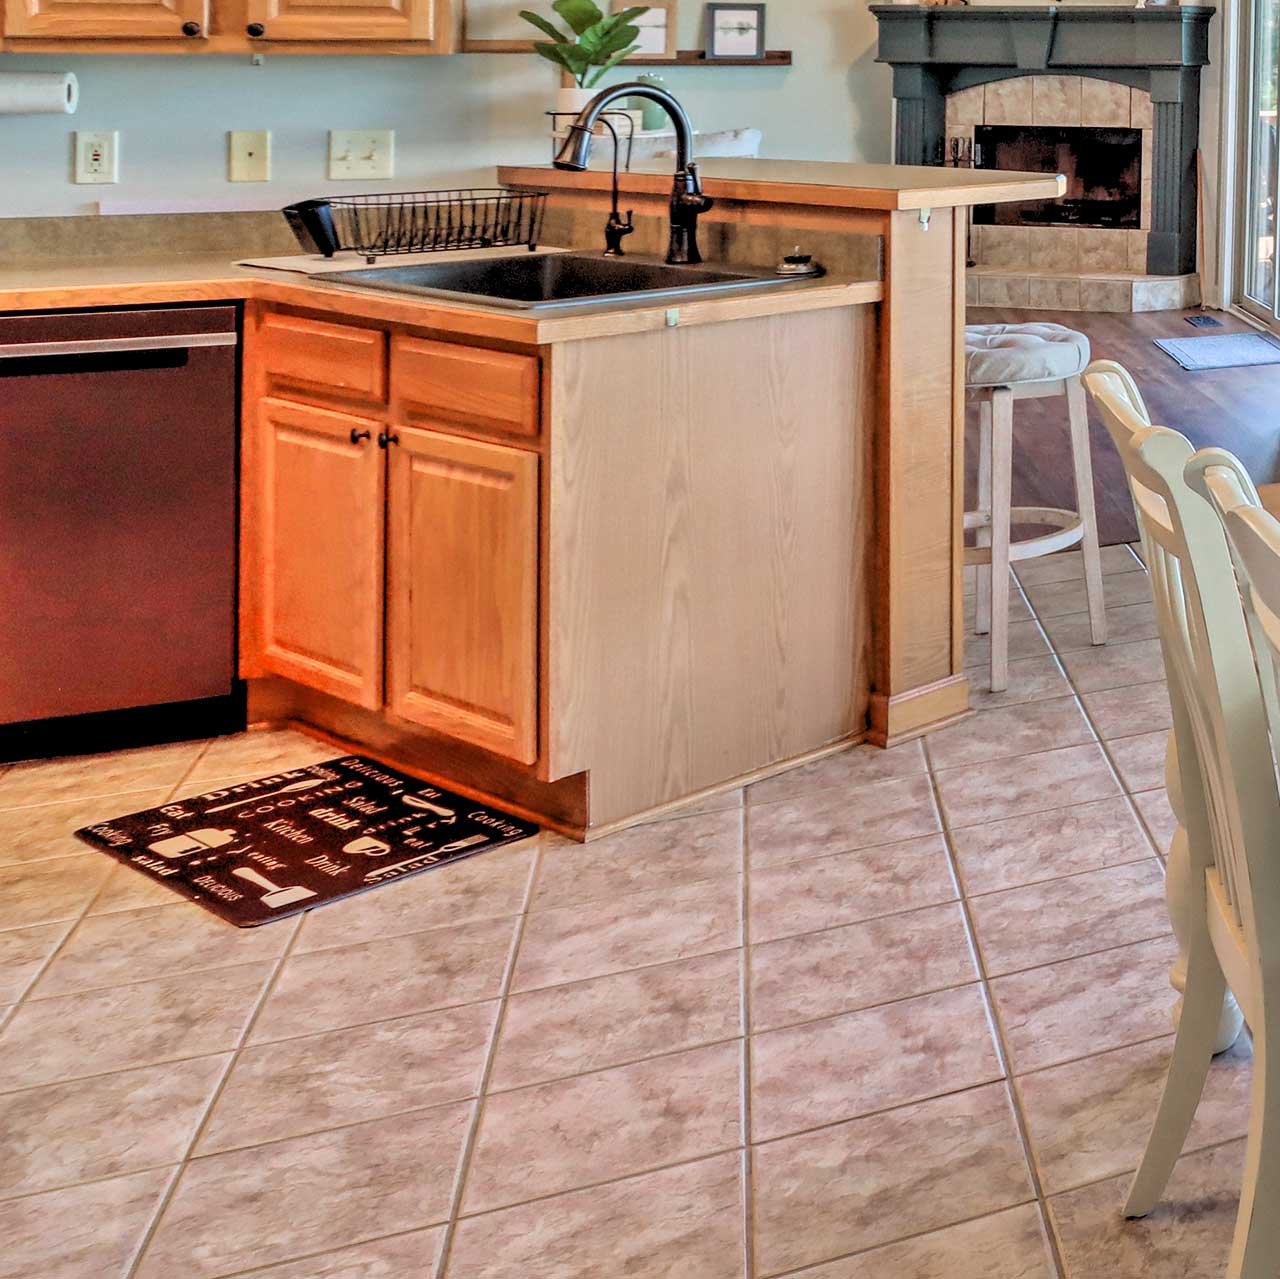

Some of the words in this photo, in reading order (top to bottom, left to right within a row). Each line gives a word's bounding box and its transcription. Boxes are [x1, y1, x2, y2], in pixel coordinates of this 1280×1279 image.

[340, 759, 404, 787] Delicious
[201, 771, 305, 801] Drink
[417, 787, 443, 799] Eat
[238, 780, 363, 818] COOKING
[341, 796, 388, 815] Salad
[160, 804, 196, 820] Eat
[308, 807, 361, 831] drink
[466, 810, 524, 837] Cooking
[87, 822, 133, 847] Cooking
[146, 823, 174, 837] Fry
[262, 818, 314, 845] Kitchen
[402, 837, 434, 849] eat
[130, 854, 180, 877] salad
[246, 851, 288, 870] eating
[303, 854, 351, 876] Drink
[362, 854, 440, 884] Salad
